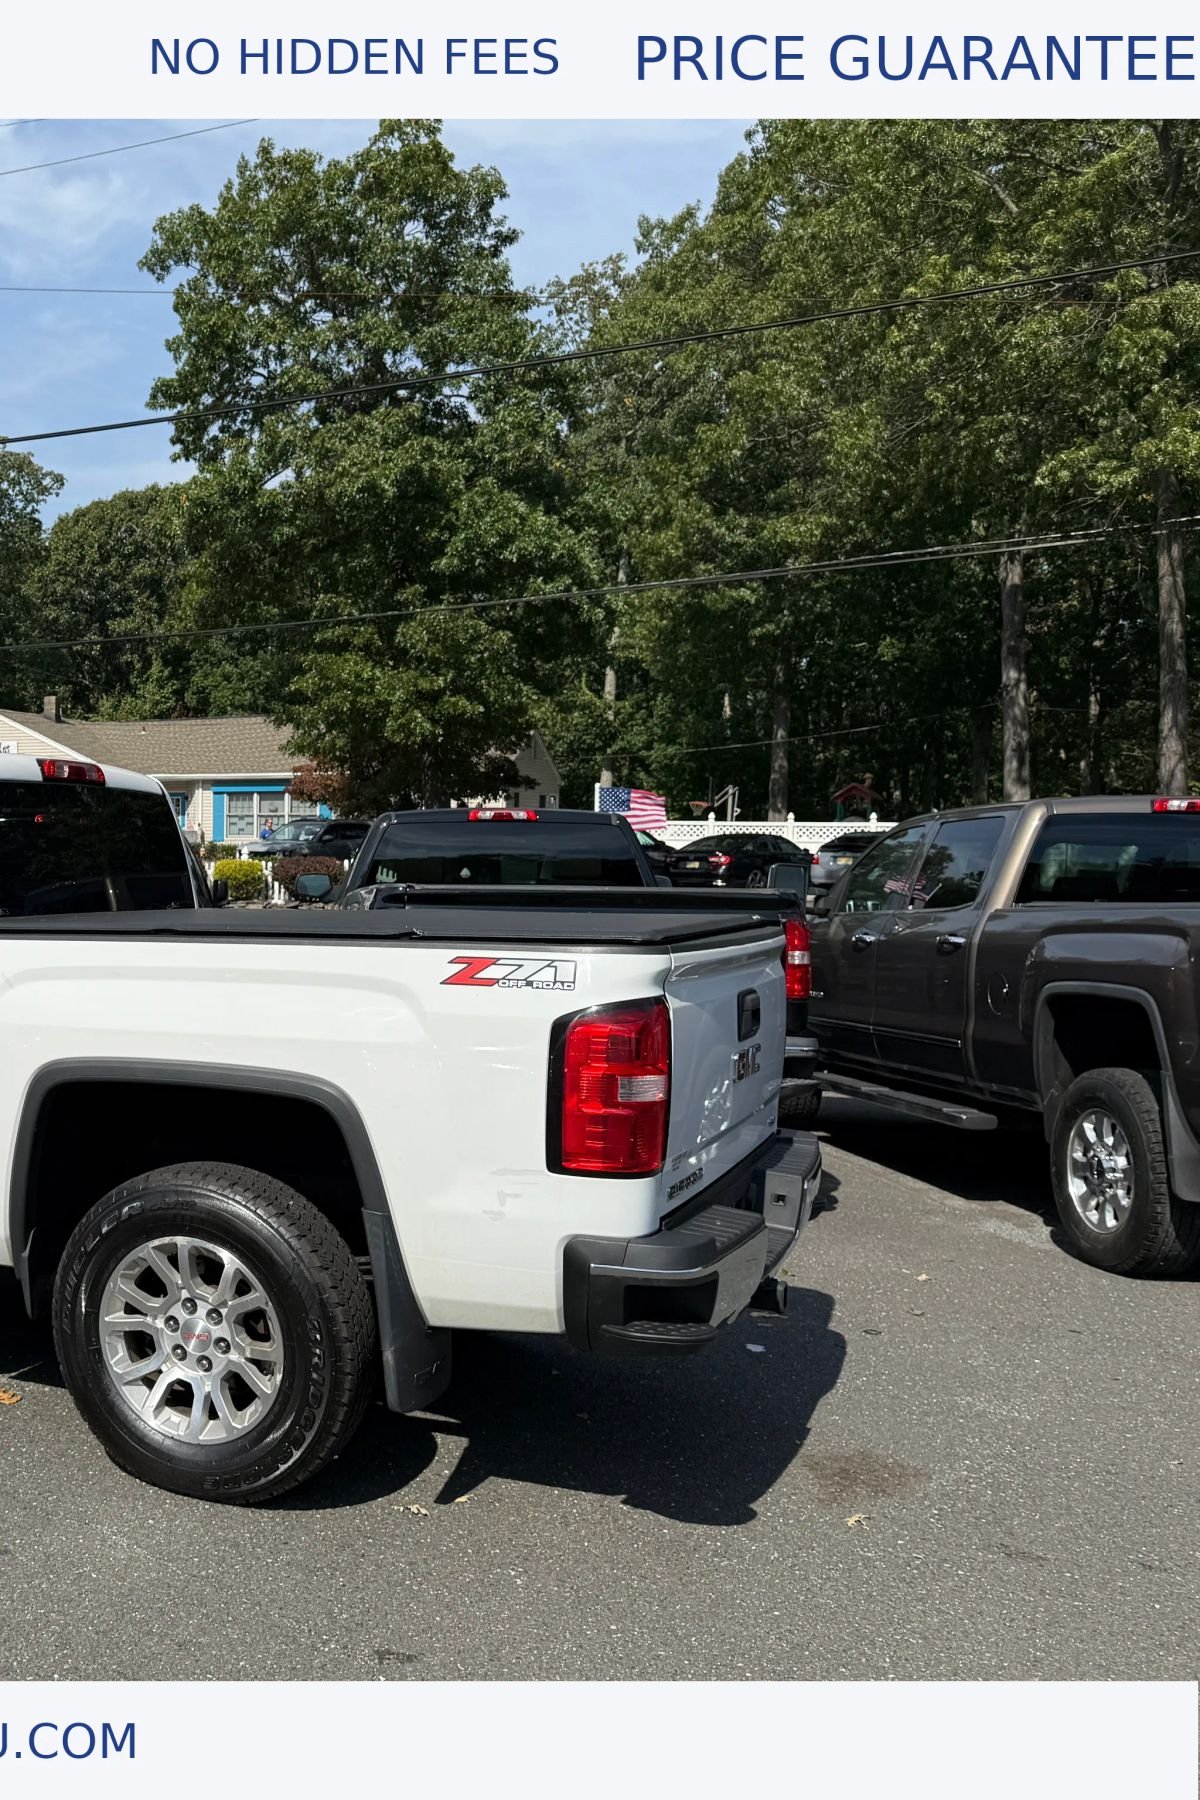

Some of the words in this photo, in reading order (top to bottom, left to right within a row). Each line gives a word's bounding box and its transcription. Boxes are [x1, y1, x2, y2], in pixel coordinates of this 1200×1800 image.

[440, 956, 577, 988] Z71
[497, 979, 527, 989] OFF
[532, 981, 576, 991] ROAD
[731, 1043, 761, 1083] GMC
